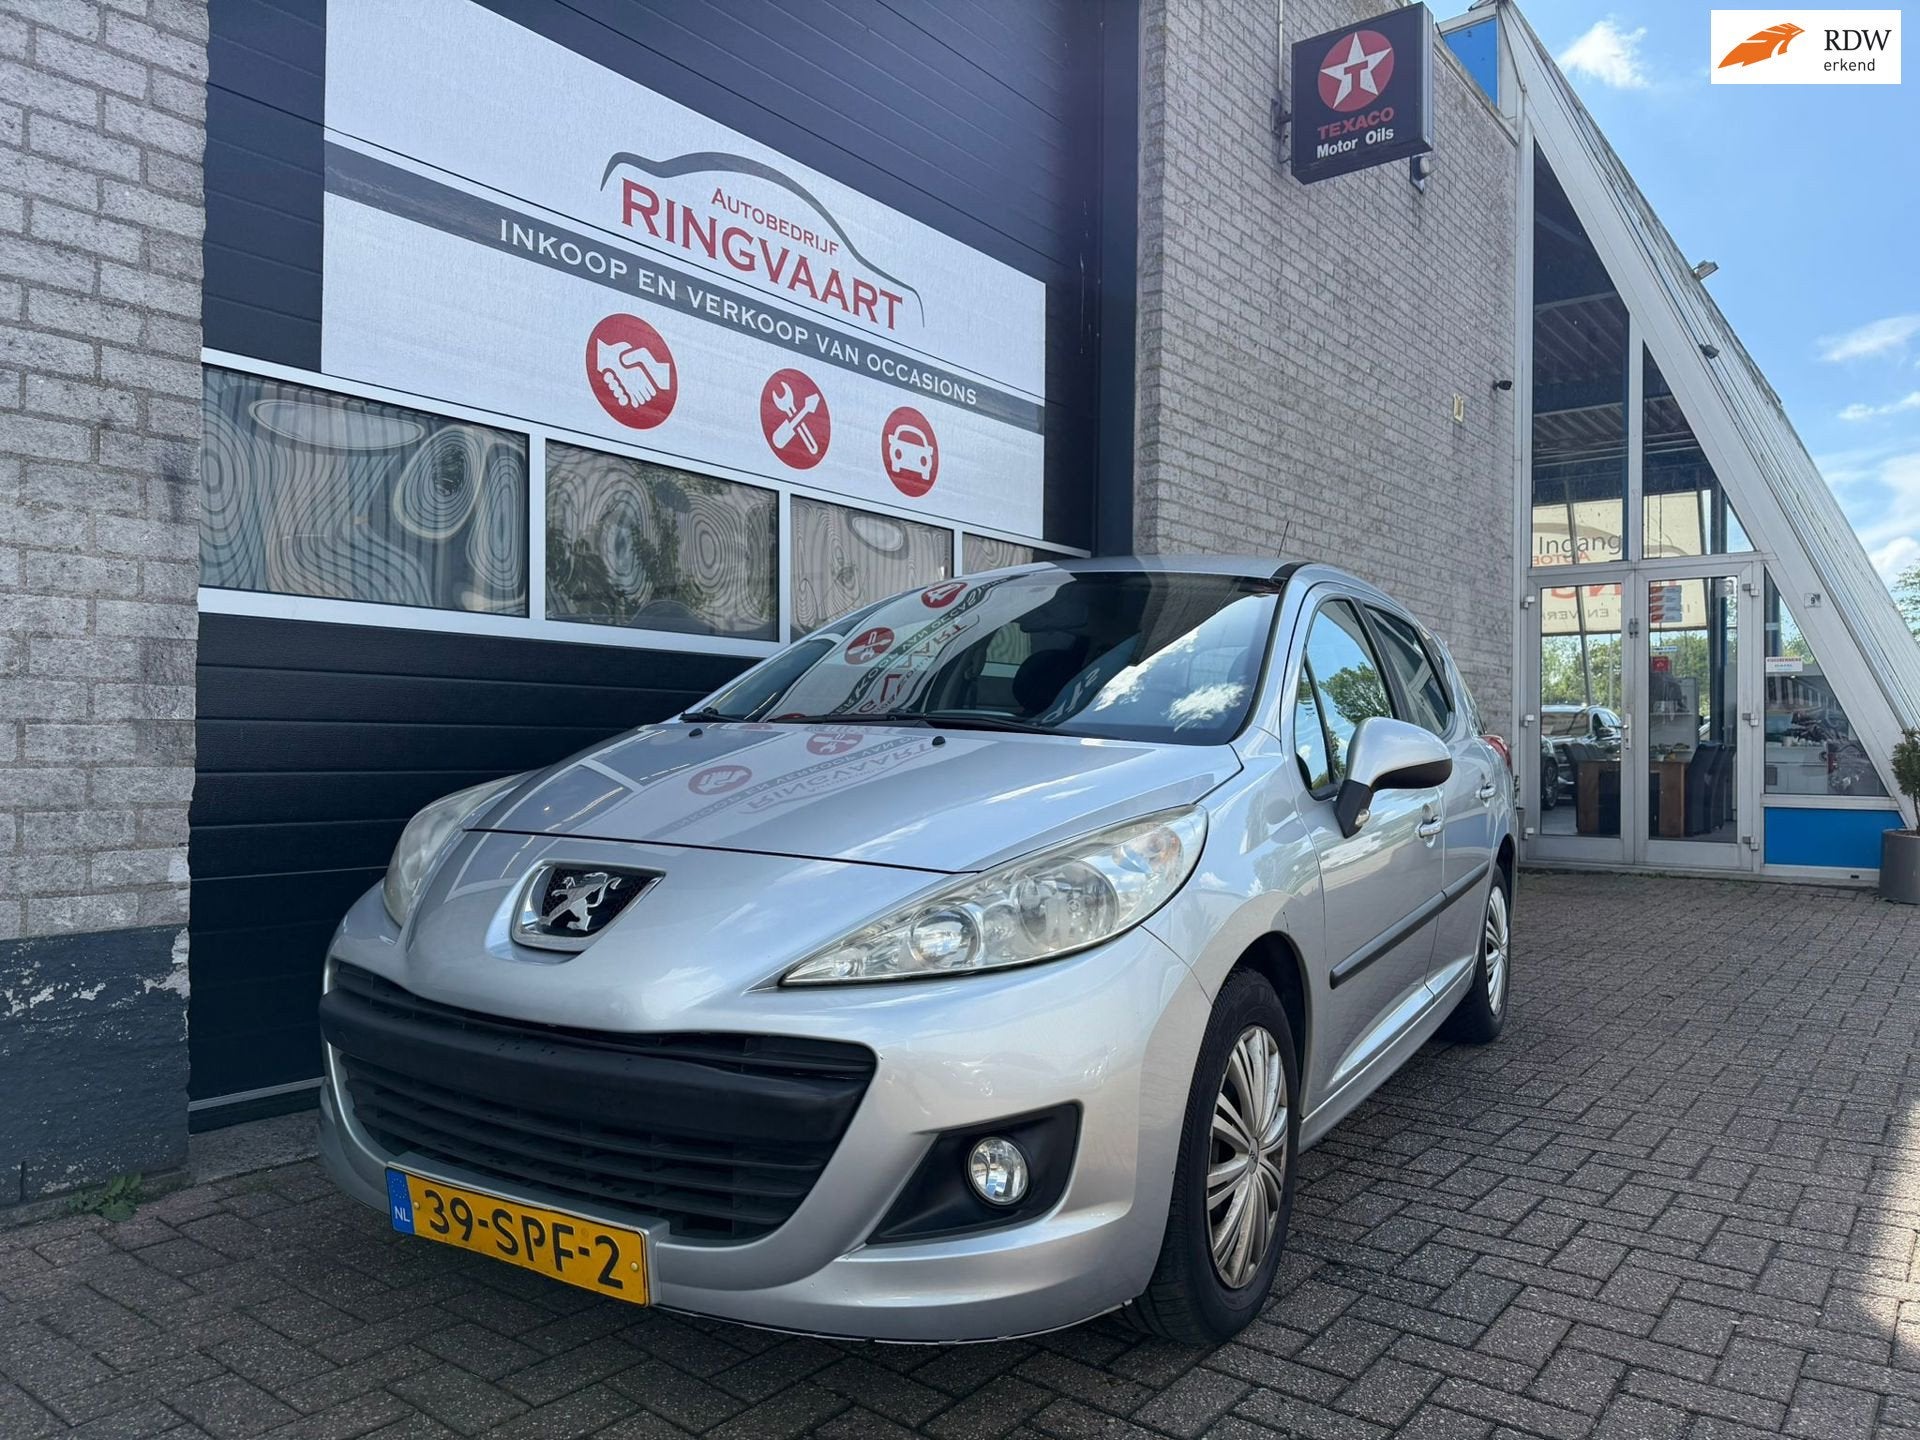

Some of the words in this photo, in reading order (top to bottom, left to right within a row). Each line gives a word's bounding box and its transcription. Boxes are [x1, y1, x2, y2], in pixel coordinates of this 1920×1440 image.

[1316, 138, 1358, 159] Motor
[1365, 128, 1394, 145] Oils
[1317, 107, 1394, 141] TEXACO
[711, 187, 839, 257] AUTOBEDRIJF
[621, 177, 903, 331] RINGVAART
[500, 218, 628, 281] INKOOP
[638, 267, 677, 301] EN
[686, 285, 808, 346] VERKOOP
[815, 332, 859, 366] VAN
[866, 352, 978, 406] OCCASIONS
[1539, 534, 1623, 556] Ingang
[395, 1205, 410, 1223] NL
[424, 1189, 624, 1290] 39-SPF-2
